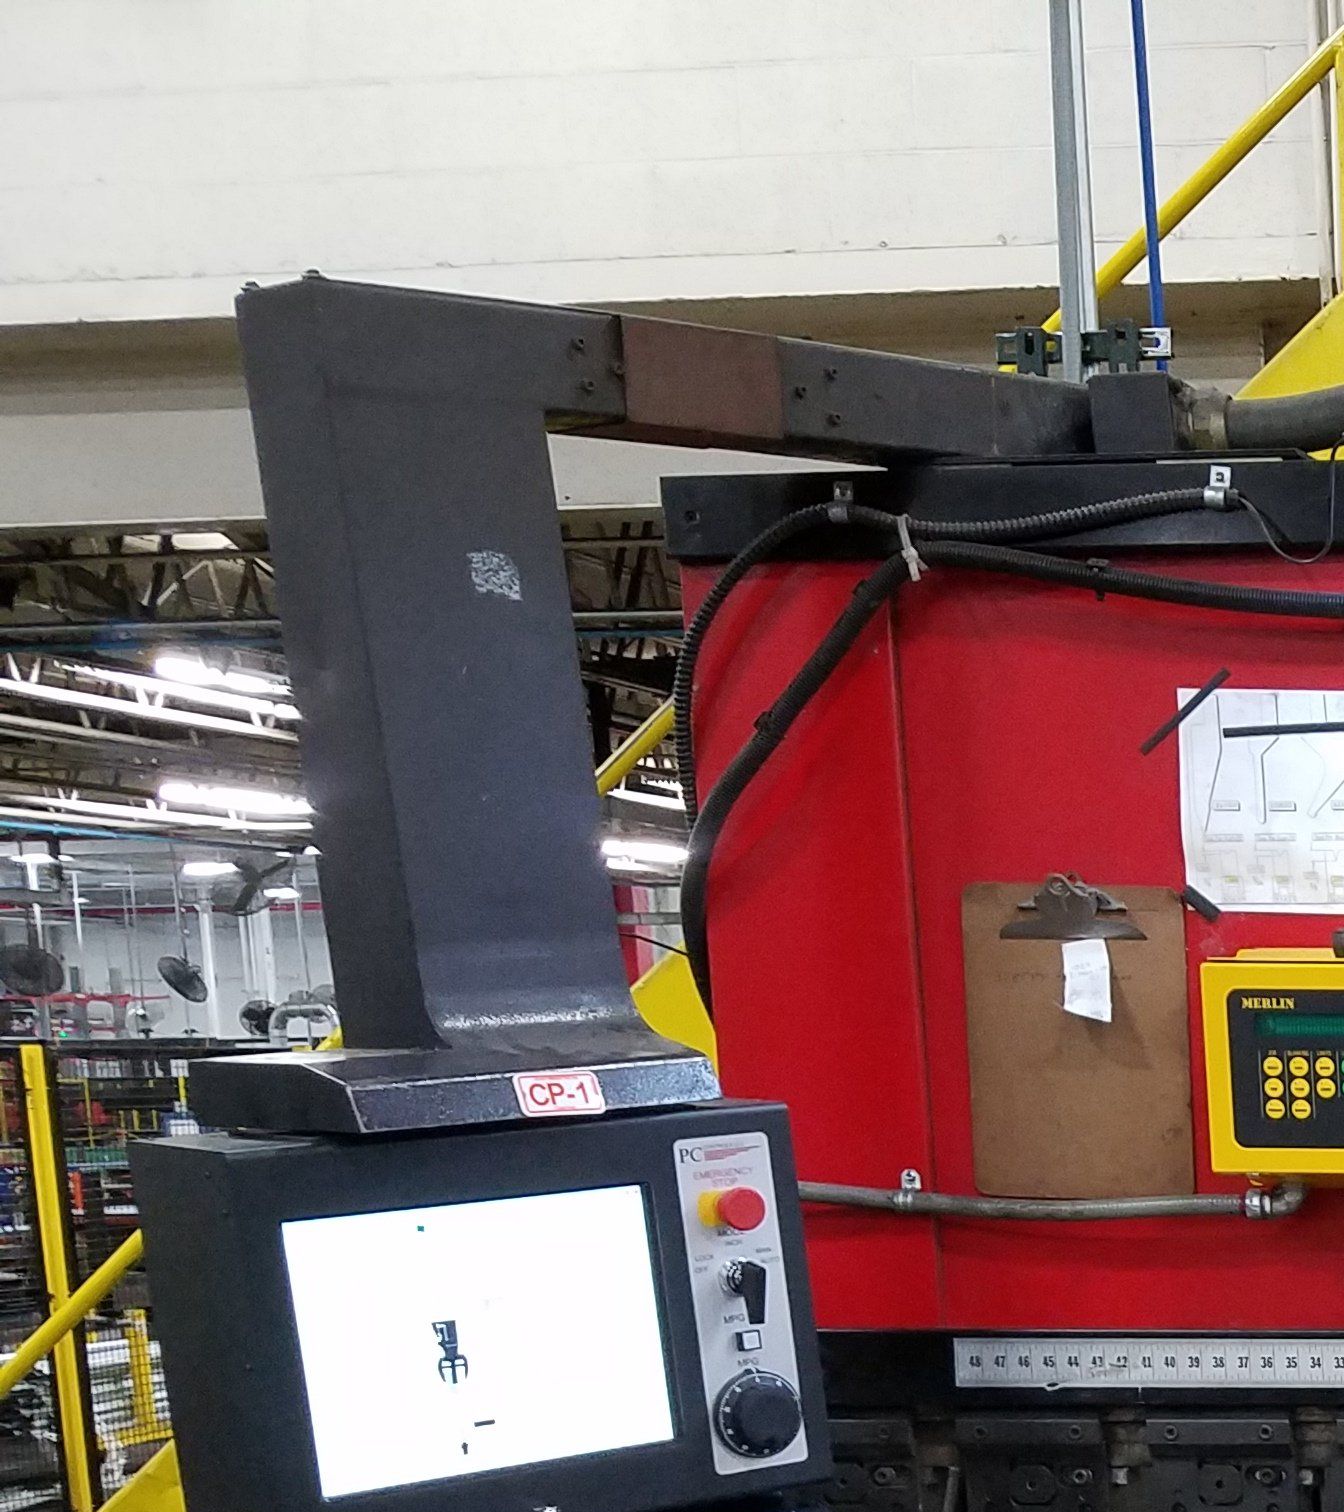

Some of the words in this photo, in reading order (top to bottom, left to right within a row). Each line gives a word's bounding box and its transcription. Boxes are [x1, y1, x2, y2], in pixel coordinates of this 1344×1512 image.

[1241, 997, 1295, 1010] MERLIN
[529, 1081, 589, 1106] CP-1
[679, 1147, 702, 1164] PC
[993, 1355, 1006, 1368] 47
[1018, 1355, 1030, 1368] 46
[1042, 1355, 1055, 1368] 45
[1067, 1355, 1079, 1368] 44
[1141, 1355, 1153, 1368] 41
[1163, 1356, 1176, 1368] 40
[1188, 1356, 1200, 1368] 39
[1212, 1356, 1225, 1368] 38
[1237, 1356, 1250, 1368] 37
[1260, 1356, 1273, 1368] 36
[1285, 1356, 1297, 1369] 35
[1310, 1356, 1322, 1369] 34
